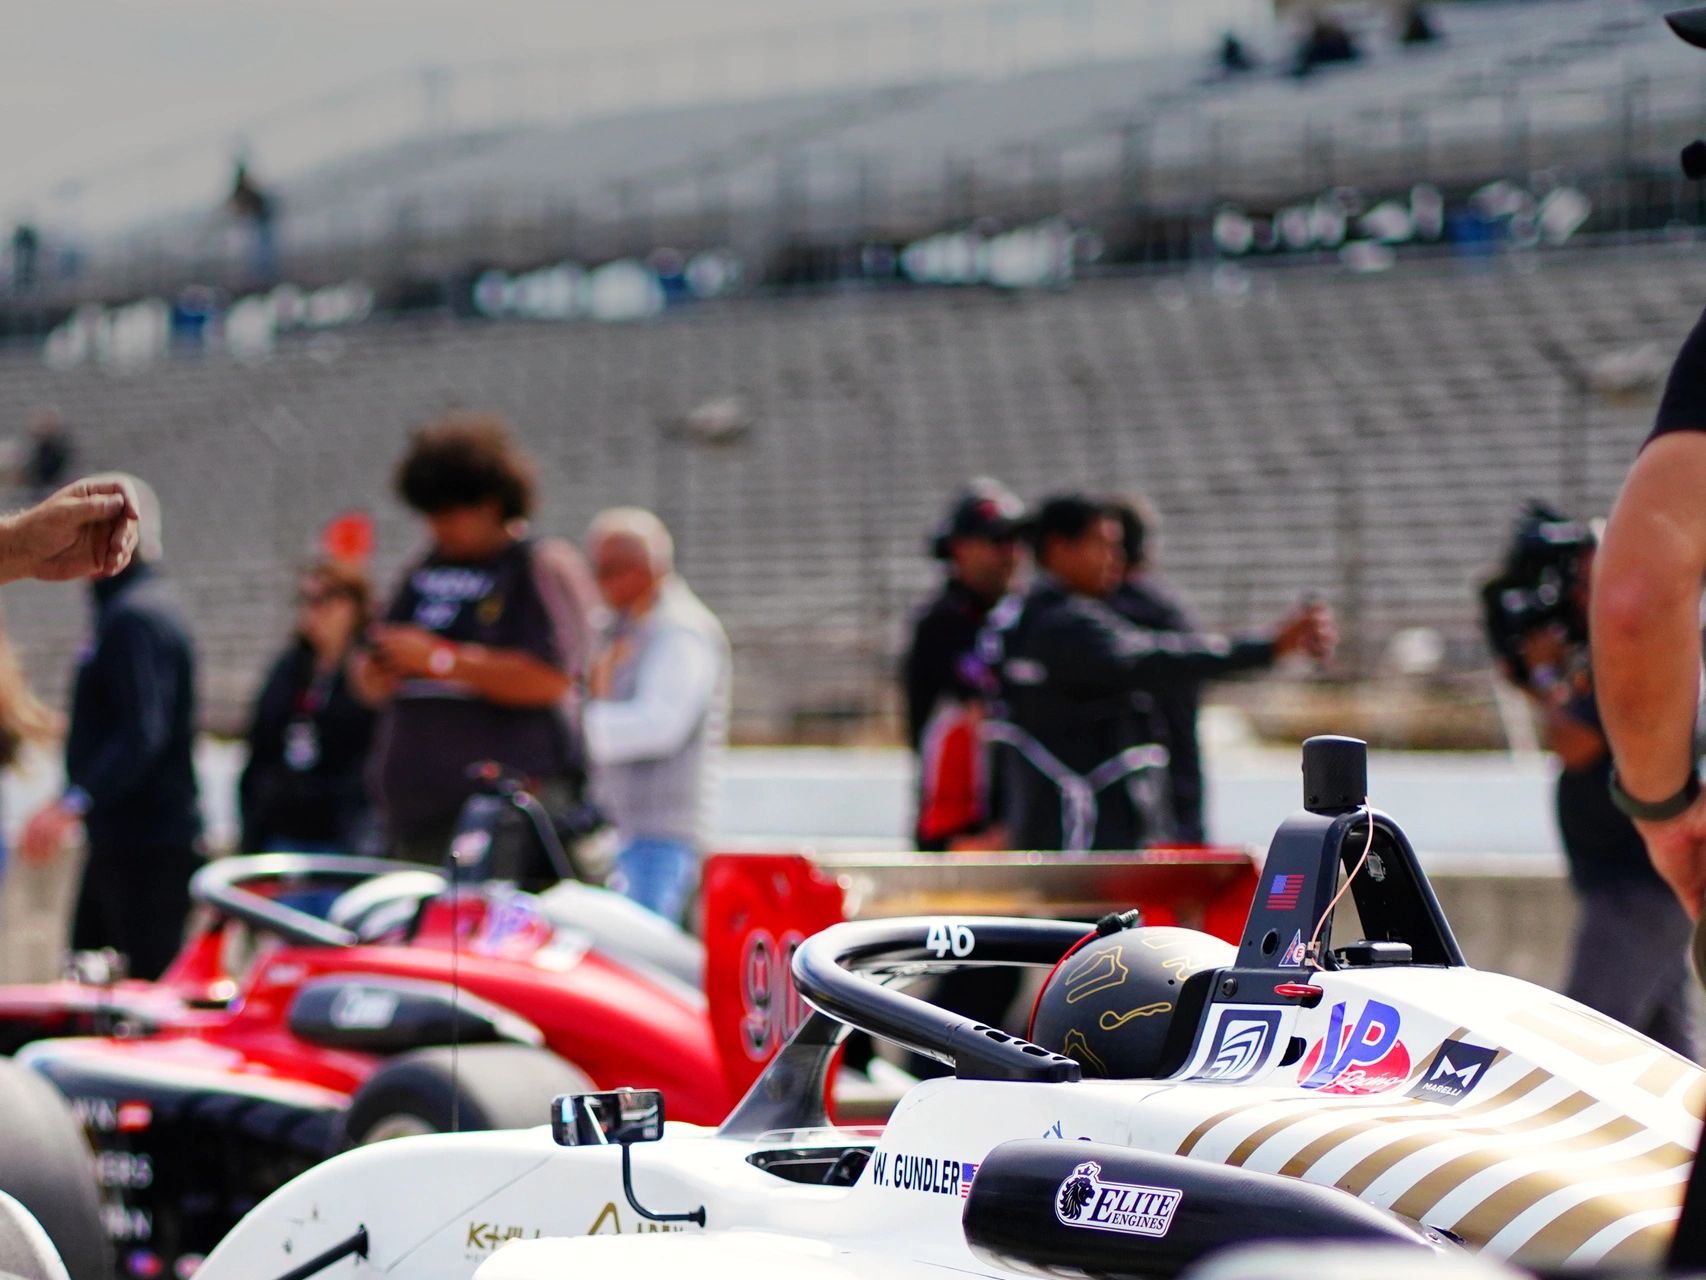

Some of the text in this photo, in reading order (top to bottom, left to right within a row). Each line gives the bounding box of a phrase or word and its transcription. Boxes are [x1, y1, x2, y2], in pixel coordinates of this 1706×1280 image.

[926, 916, 976, 958] 46
[1299, 999, 1402, 1091] VP
[1420, 1082, 1463, 1097] MARELLI
[873, 1151, 961, 1196] W. GUNDLER
[1087, 1187, 1176, 1223] ELITE
[1111, 1211, 1166, 1231] ENGINES
